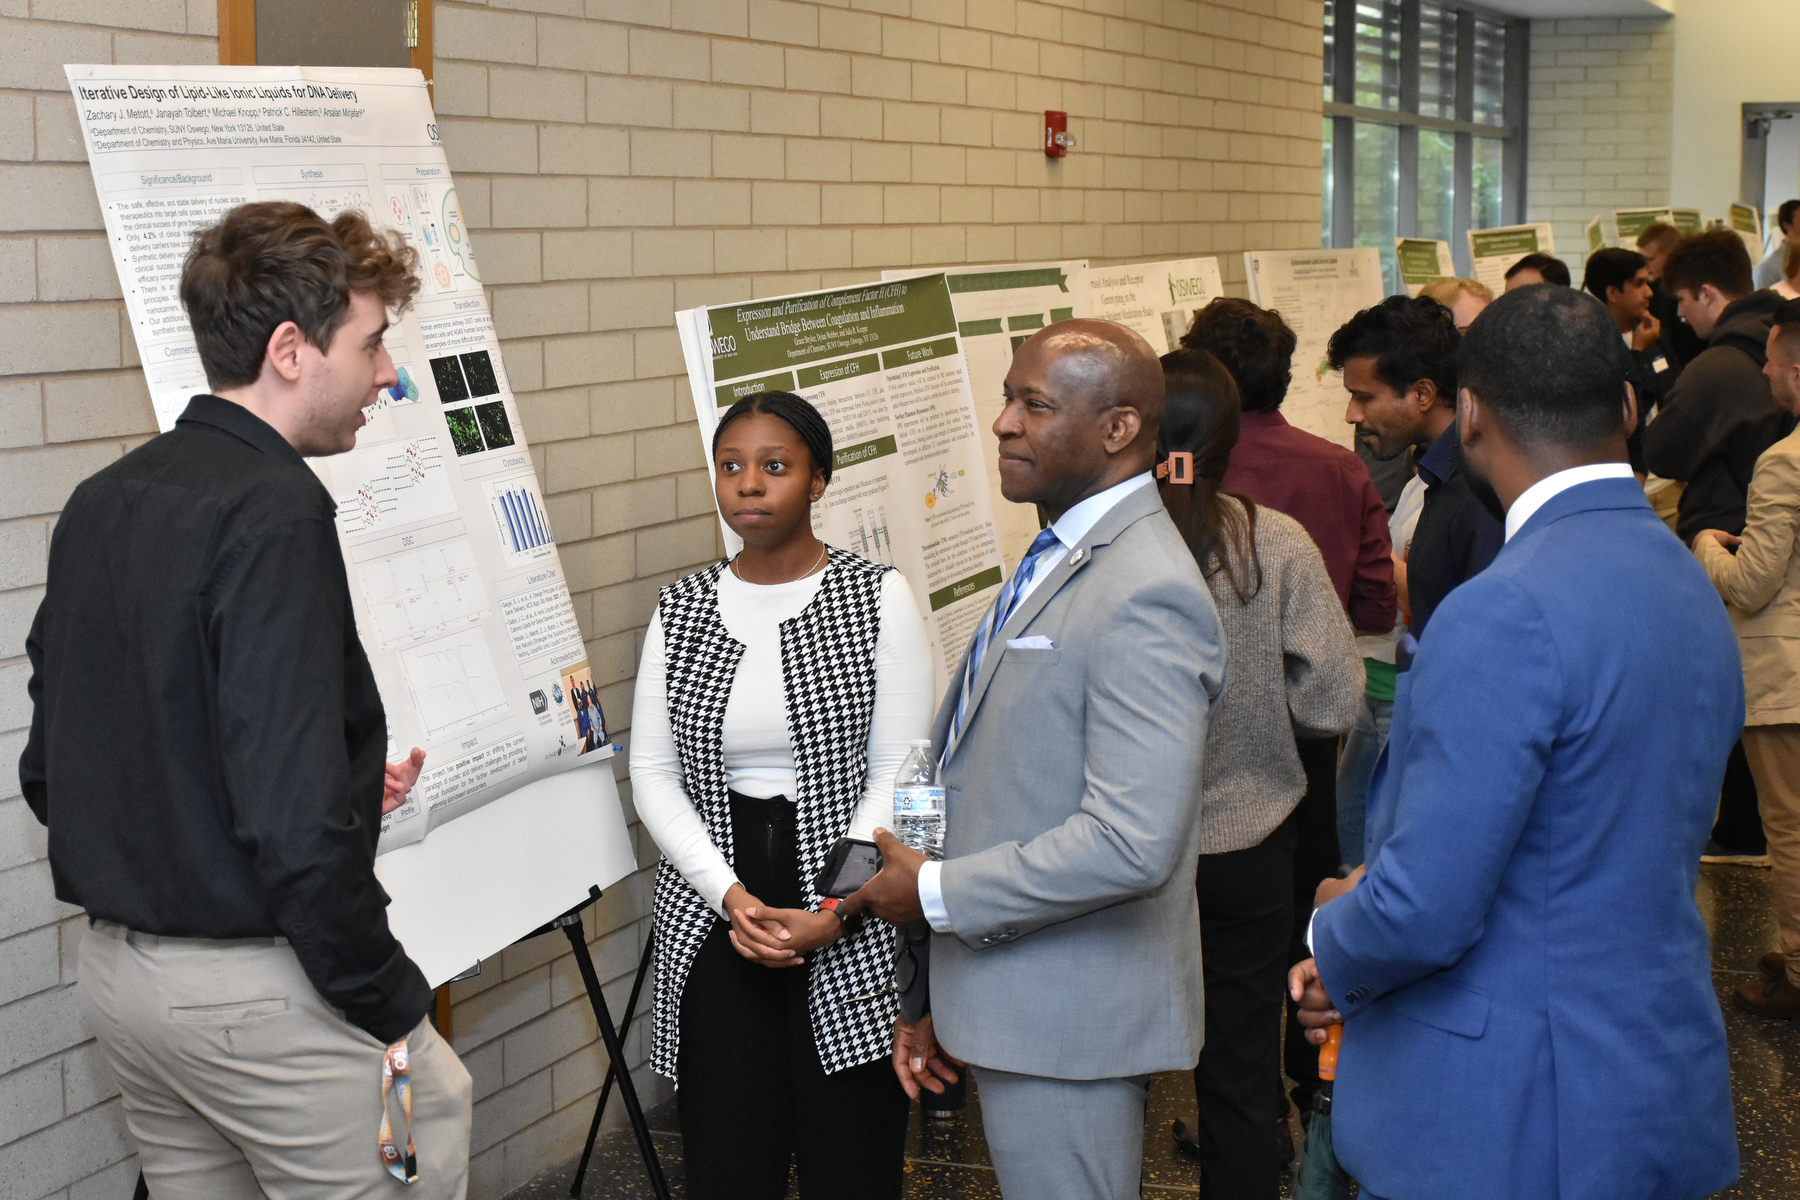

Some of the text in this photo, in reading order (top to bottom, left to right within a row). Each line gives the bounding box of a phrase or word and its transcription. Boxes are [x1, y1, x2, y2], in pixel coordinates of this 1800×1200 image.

[78, 86, 358, 103] Iterative Design of Lipid-Like Ionic Liquids for DNA Delivery
[86, 110, 116, 121] Zachary
[119, 109, 125, 119] J.
[156, 108, 182, 120] Janayah
[212, 108, 236, 117] Michael
[262, 107, 282, 116] Patrick
[284, 107, 291, 116] C.
[324, 108, 342, 117] Arsalan
[132, 126, 138, 134] of
[138, 126, 168, 135] Chemistry,
[169, 125, 185, 133] SUNY
[187, 125, 211, 134] Oswego,
[212, 124, 223, 132] New
[224, 124, 236, 132] York
[237, 124, 255, 132] 13126,
[256, 124, 272, 132] United
[272, 124, 285, 132] State
[427, 123, 440, 140] OS
[136, 139, 142, 147] of
[142, 138, 171, 148] Chemistry
[172, 138, 182, 146] and
[183, 137, 206, 146] Physics,
[206, 137, 216, 145] Ave
[216, 137, 232, 145] Maria
[233, 136, 258, 145] University,
[268, 136, 284, 144] Maria,
[285, 135, 300, 143] Florida
[317, 135, 331, 143] United
[330, 135, 342, 143] State
[300, 169, 324, 179] Synthesis
[416, 167, 442, 176] Preparation
[140, 173, 212, 186] Significance/Background
[117, 202, 129, 210] The
[176, 198, 190, 206] stable
[191, 198, 207, 207] delivery
[120, 212, 153, 221] therapeutics
[164, 210, 177, 219] target
[189, 209, 202, 217] poses
[126, 234, 140, 242] Only
[453, 300, 480, 310] Transfection
[736, 305, 771, 325] Expression
[772, 302, 783, 317] and
[784, 297, 819, 315] Purification
[820, 296, 828, 309] of
[827, 293, 862, 309] Complement
[862, 289, 879, 301] Factor
[745, 302, 905, 341] Understand Bridge Between Coagulation and Inflammation
[164, 346, 199, 356] Commercia
[711, 335, 736, 355] WEGO
[907, 346, 933, 360] Future Work
[819, 366, 844, 381] Expression
[850, 362, 860, 373] CFH
[733, 381, 765, 397] Introduction
[836, 444, 877, 465] Purification of CFH
[402, 536, 415, 547] DSC
[527, 570, 556, 584] Literature Cited
[953, 582, 975, 597] References
[531, 695, 545, 709] NIH
[461, 737, 478, 749] Impact
[432, 769, 445, 778] project
[456, 760, 470, 769] positive
[472, 753, 485, 762] impact
[492, 745, 504, 754] shifting
[513, 736, 524, 745] current
[425, 782, 443, 793] paradigm
[470, 764, 484, 773] delivery
[401, 806, 415, 816] Profile
